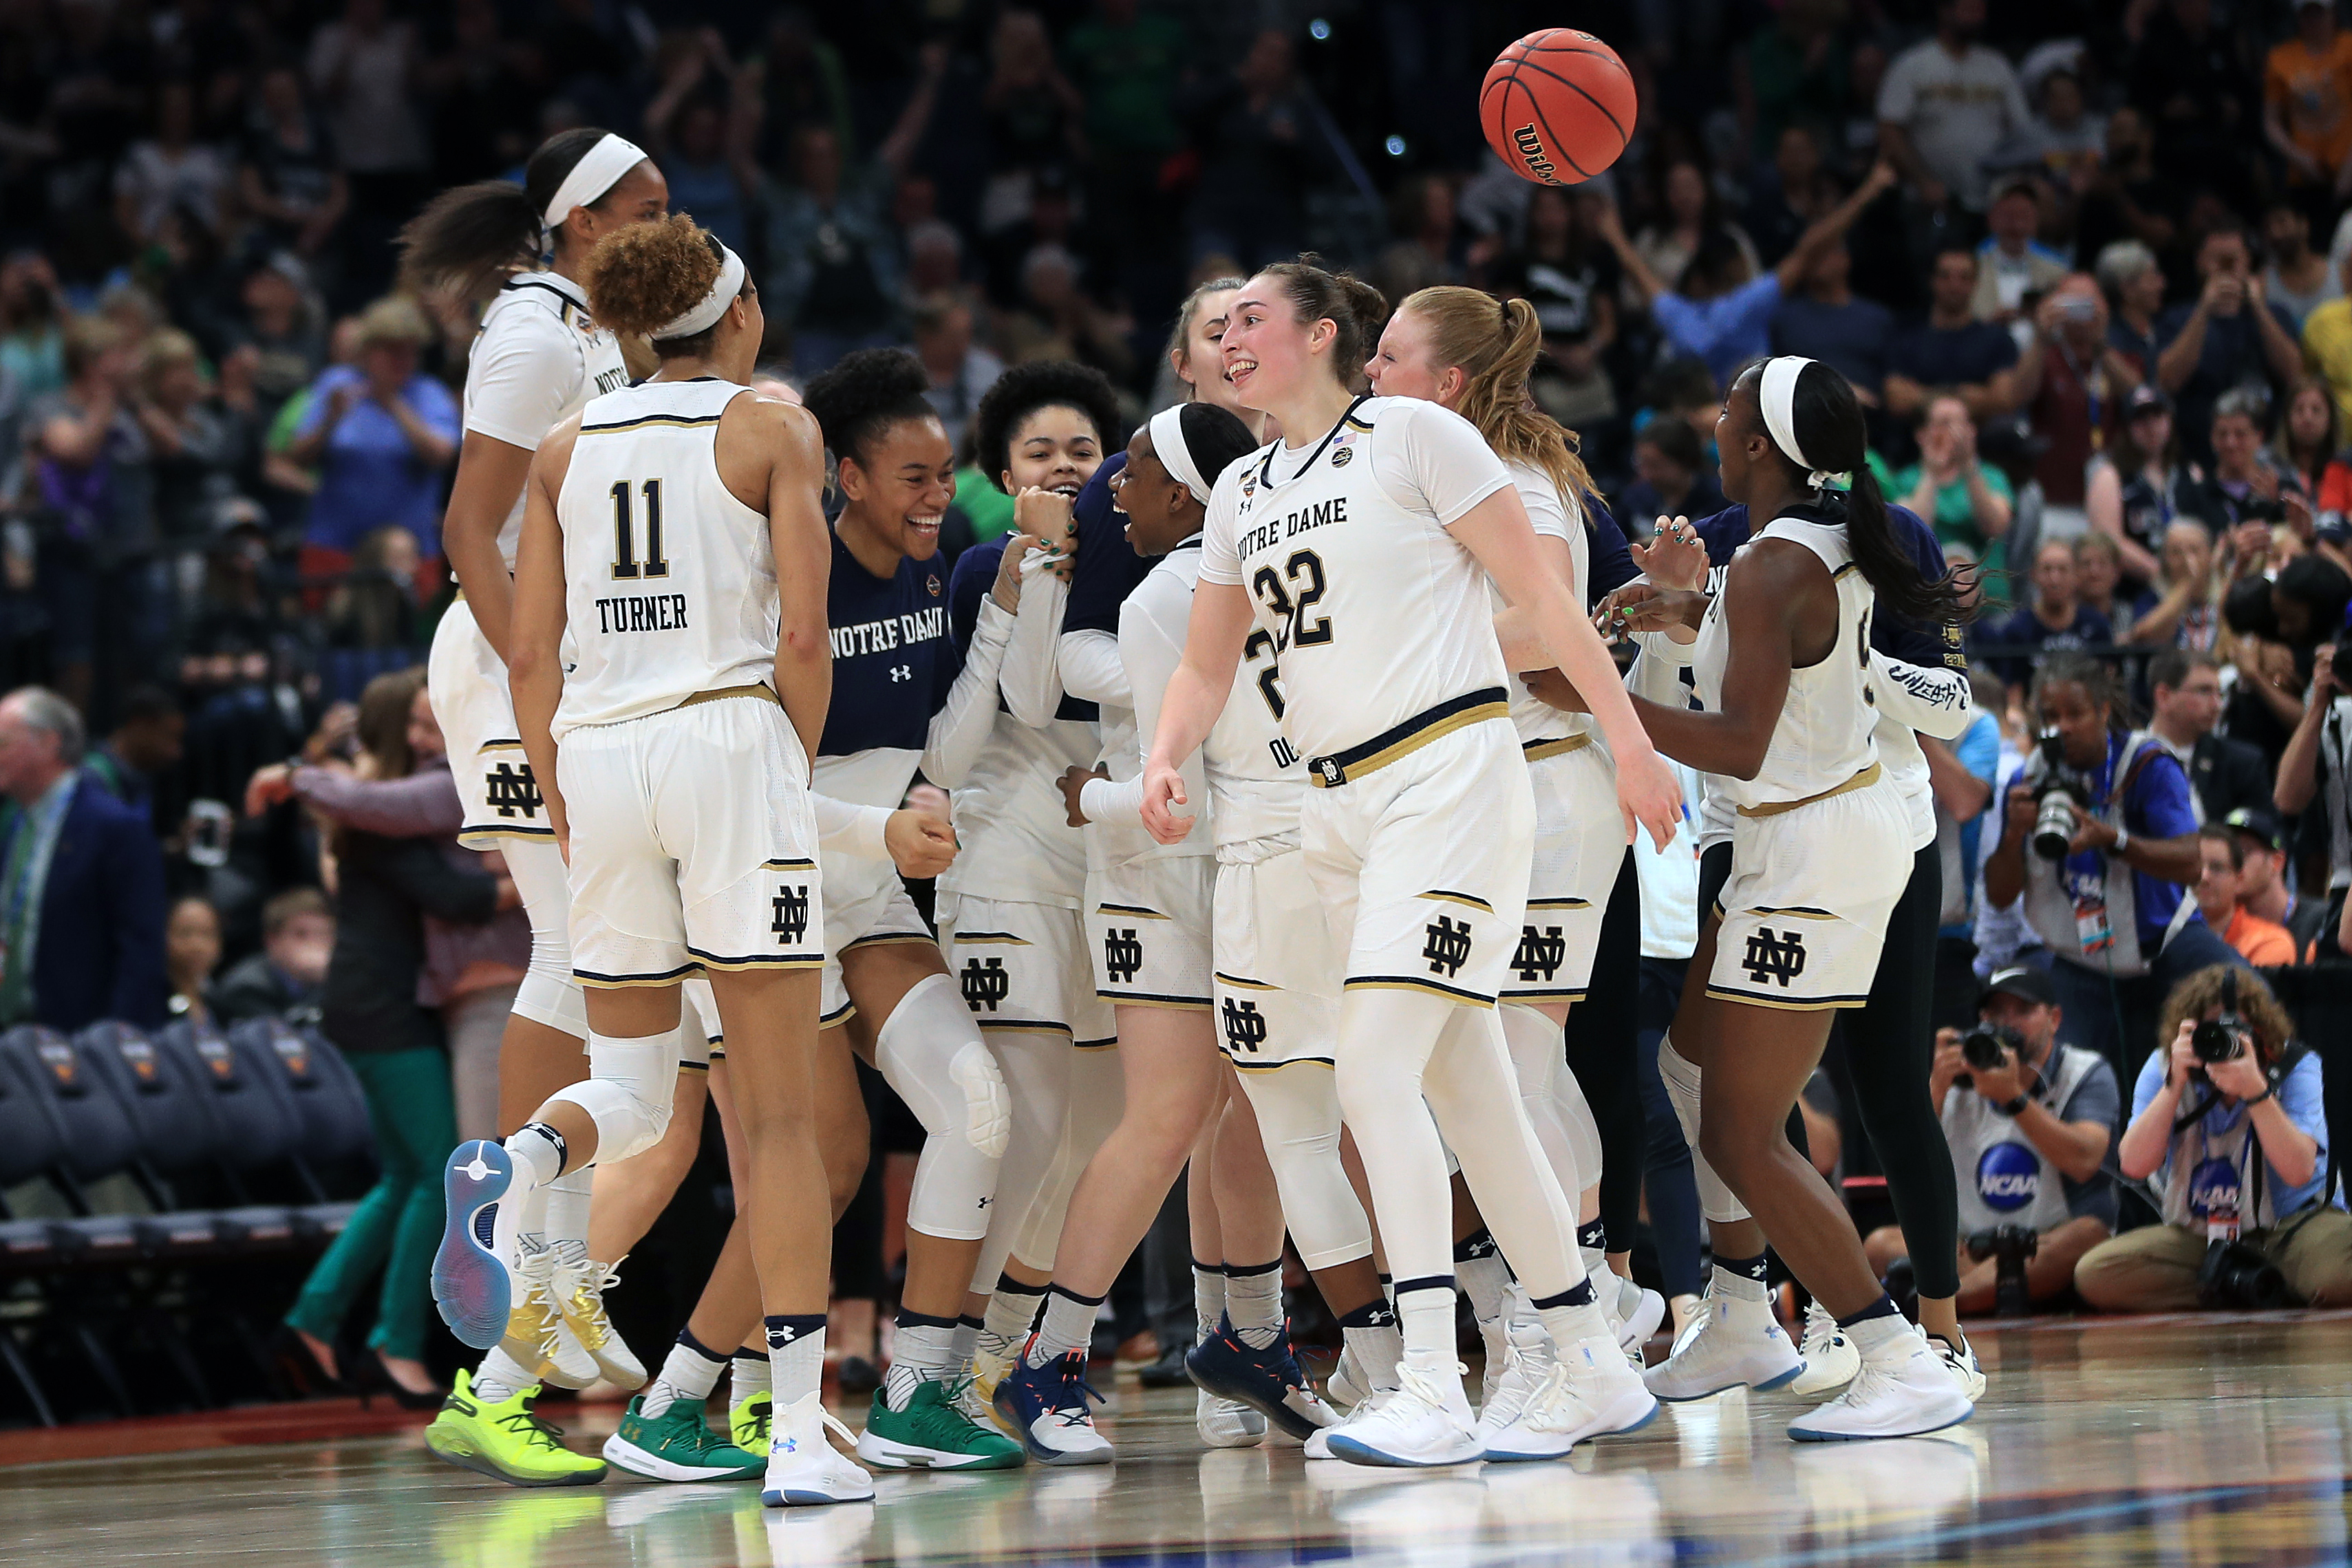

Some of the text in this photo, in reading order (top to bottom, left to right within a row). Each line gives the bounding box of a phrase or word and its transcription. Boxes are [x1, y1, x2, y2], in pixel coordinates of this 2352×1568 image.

[1512, 122, 1566, 186] Wilso
[610, 478, 669, 580] 11
[1286, 497, 1347, 539] DAME
[596, 594, 687, 634] TURNER
[1252, 548, 1334, 654] 32
[828, 607, 943, 658] NOTRE DAM
[1943, 653, 1967, 669] 201
[1980, 1174, 2038, 1197] NCAA
